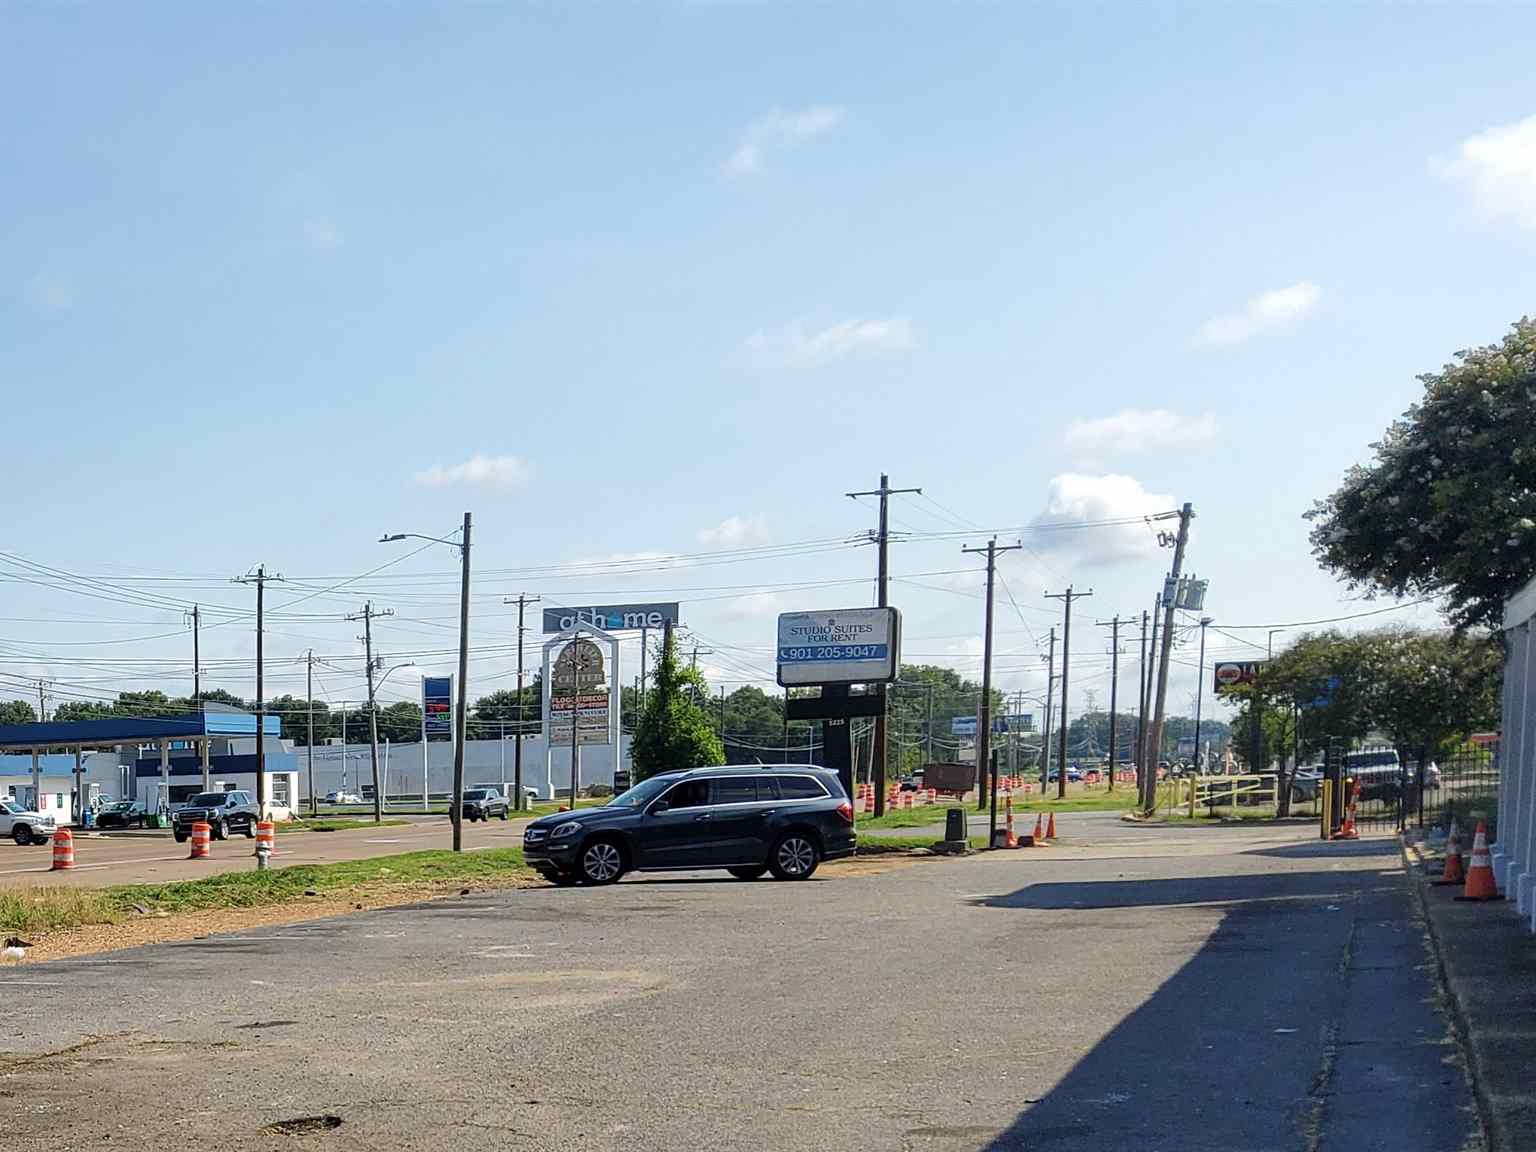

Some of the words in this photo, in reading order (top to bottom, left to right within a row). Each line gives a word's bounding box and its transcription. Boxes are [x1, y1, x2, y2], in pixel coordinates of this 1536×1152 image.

[791, 625, 832, 636] STUDIO
[834, 624, 873, 634] SUITES
[807, 634, 829, 643] FOR
[830, 633, 857, 642] RENT
[789, 648, 814, 660] 901
[817, 645, 877, 658] 205-9047
